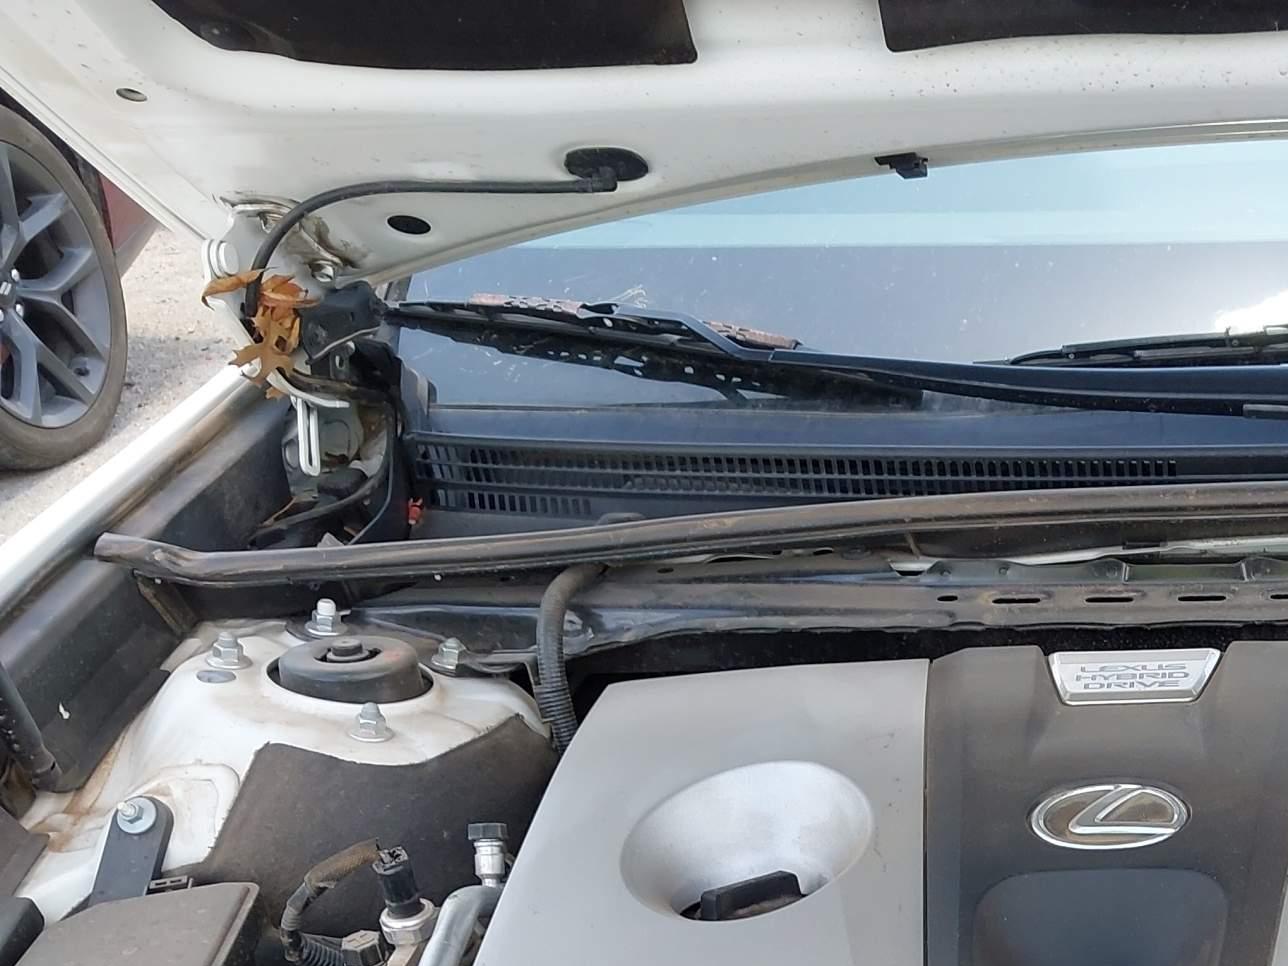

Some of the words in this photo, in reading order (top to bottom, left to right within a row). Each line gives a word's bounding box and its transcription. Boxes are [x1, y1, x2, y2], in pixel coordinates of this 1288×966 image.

[1080, 663, 1187, 673] LEXUS
[1075, 671, 1190, 682] HYBRID
[1083, 680, 1180, 690] DRIVE
